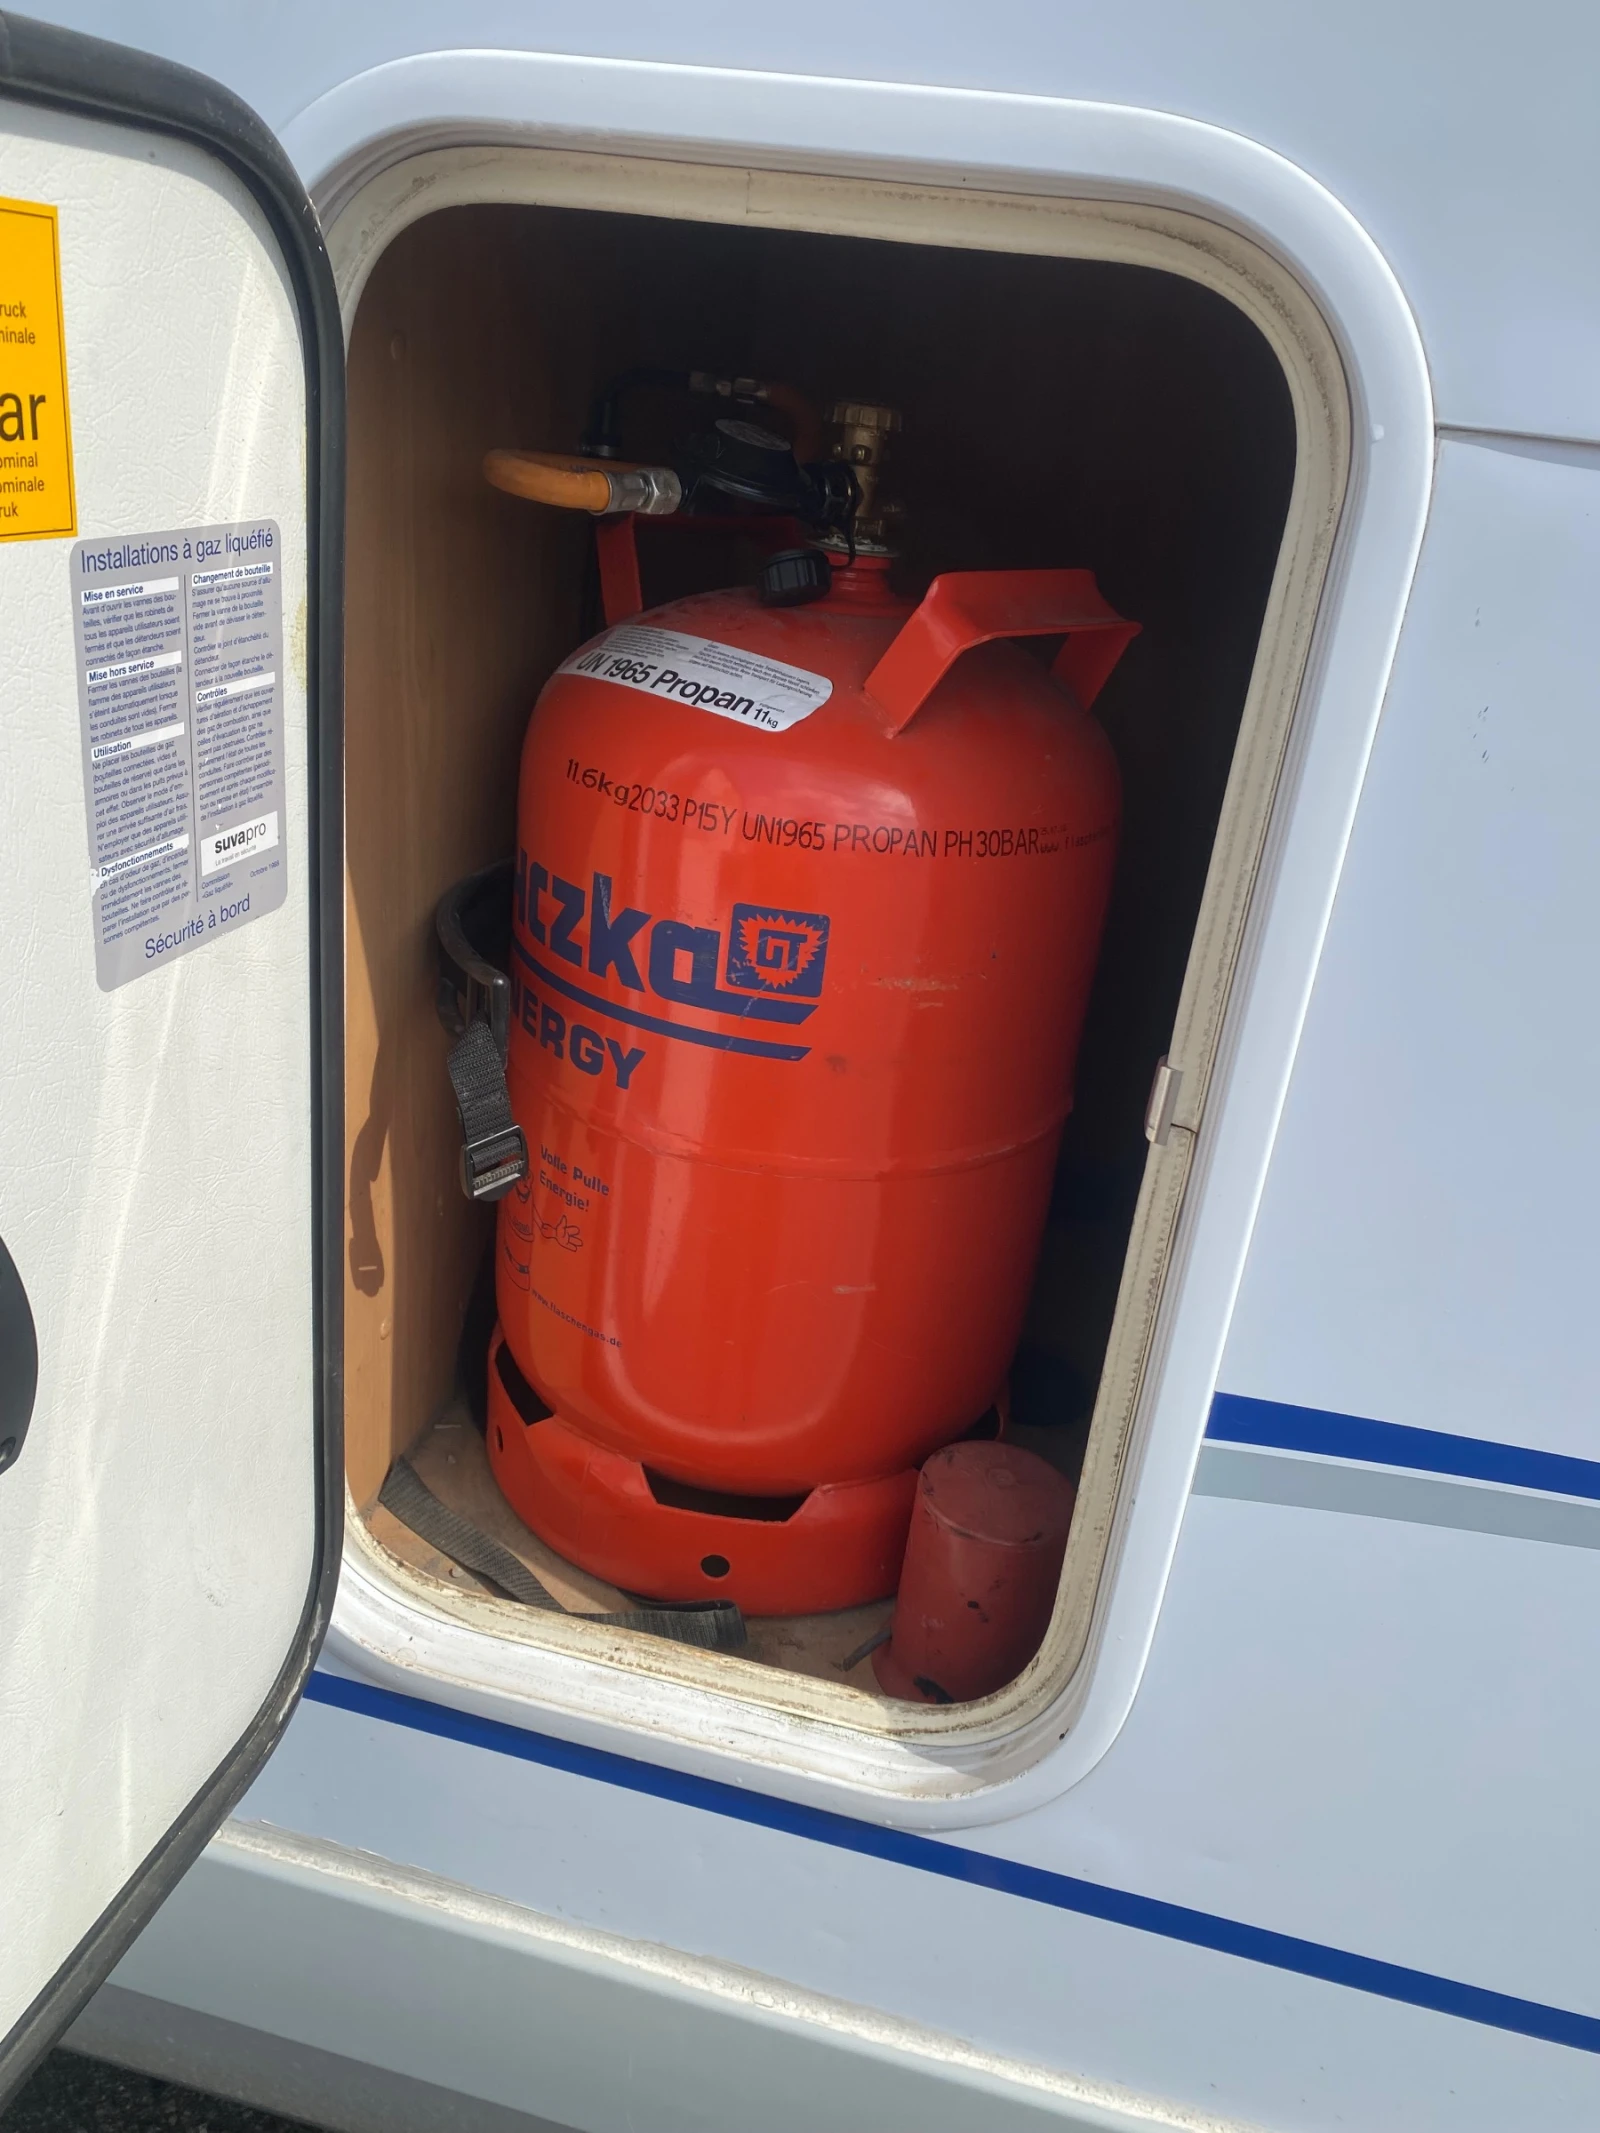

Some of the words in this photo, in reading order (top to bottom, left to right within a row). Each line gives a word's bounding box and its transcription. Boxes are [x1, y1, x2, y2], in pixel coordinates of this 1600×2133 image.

[0, 392, 46, 442] ar
[81, 542, 179, 573] Installations
[183, 538, 192, 559] à
[196, 540, 221, 562] gaz
[225, 528, 273, 557] liquéfié
[84, 591, 103, 602] Mise
[105, 590, 115, 599] en
[116, 585, 143, 597] service
[194, 569, 234, 584] Changement
[235, 568, 243, 577] de
[245, 563, 270, 575] bouteille
[88, 671, 108, 682] Mise
[109, 667, 127, 677] hors
[128, 660, 154, 673] service
[577, 652, 612, 672] UN
[603, 658, 658, 684] 1965
[650, 669, 754, 715] Propan
[754, 708, 770, 722] 11
[767, 717, 778, 729] kg
[94, 741, 131, 758] Utilisation
[215, 822, 266, 854] suvapro
[742, 811, 825, 851] UN1965
[833, 824, 937, 857] PROPAN
[101, 842, 173, 876] Dysfonctionnements
[145, 917, 204, 959] Sécurité
[208, 910, 216, 929] à
[220, 893, 250, 923] bord
[539, 1169, 588, 1213] Energie!
[540, 1144, 567, 1174] Volle
[572, 1166, 610, 1196] Pulle
[531, 1288, 622, 1349] www.flaschengas.de
